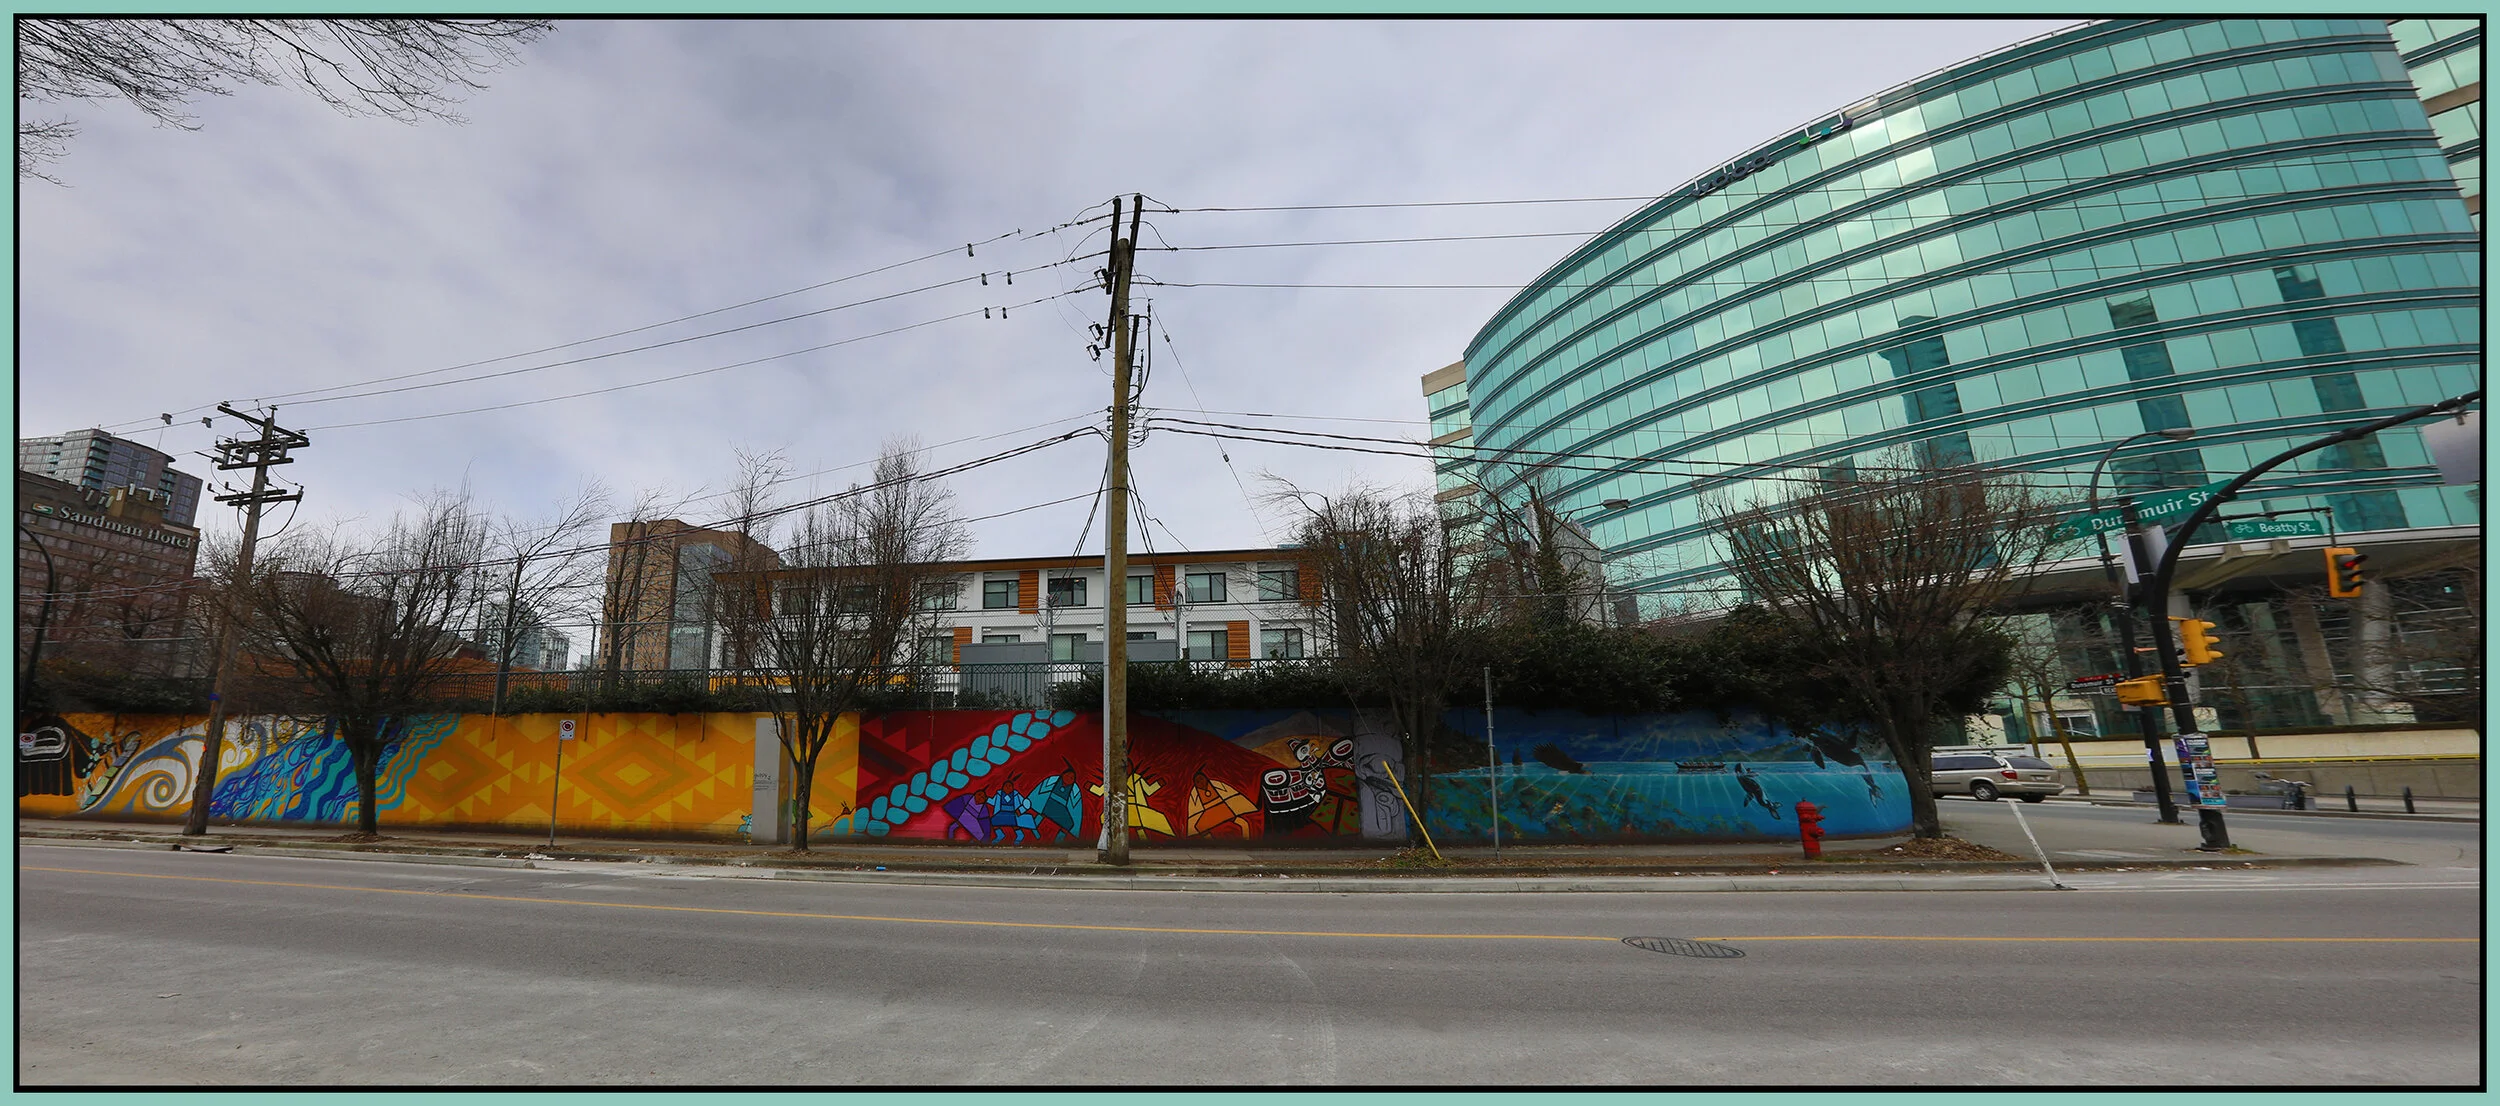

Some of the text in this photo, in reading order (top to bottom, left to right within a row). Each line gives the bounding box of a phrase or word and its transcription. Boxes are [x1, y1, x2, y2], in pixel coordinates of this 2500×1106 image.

[59, 505, 191, 548] Sandman Hotel
[2259, 523, 2298, 534] Beatty
